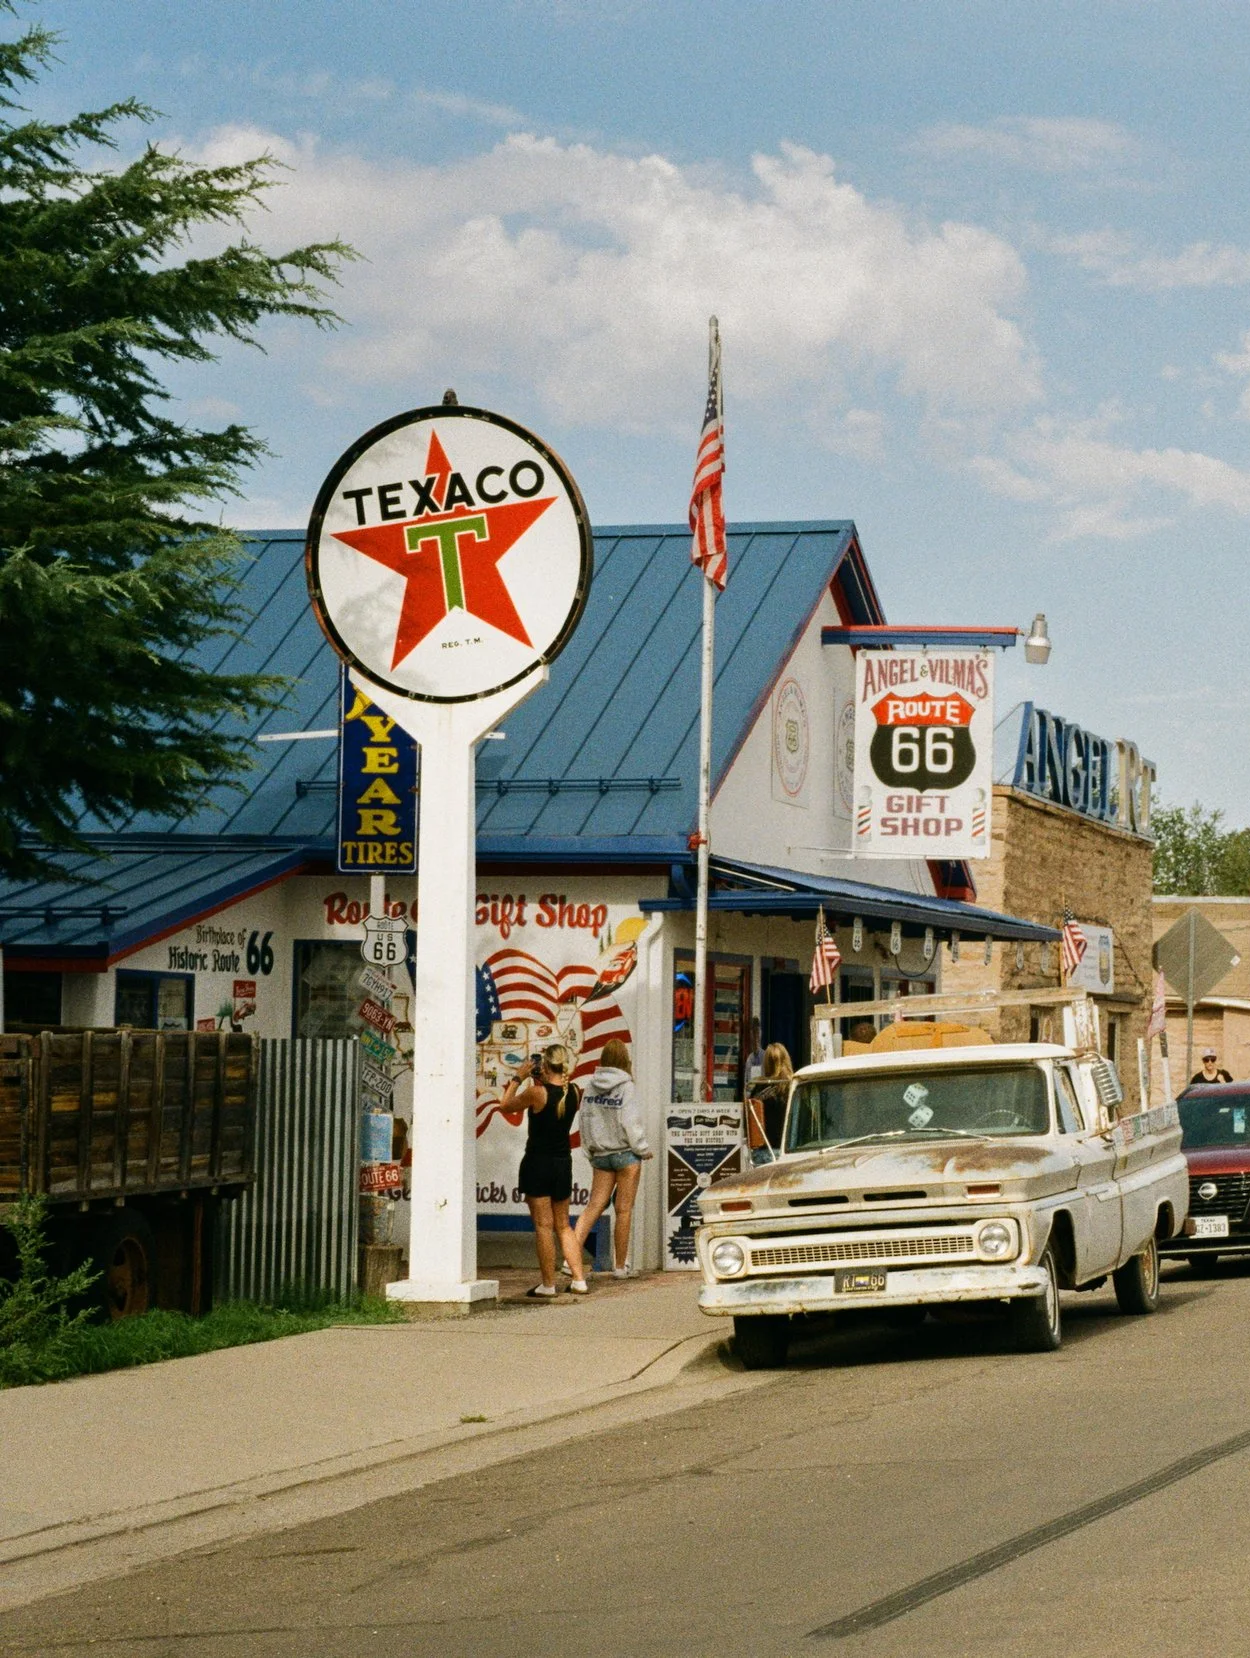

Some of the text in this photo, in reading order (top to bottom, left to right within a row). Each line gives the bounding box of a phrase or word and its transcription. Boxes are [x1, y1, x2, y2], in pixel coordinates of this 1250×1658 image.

[343, 460, 545, 526] TEXACO
[862, 654, 989, 703] ANGEL & VILMA'S
[886, 700, 960, 724] ROUTE
[891, 726, 954, 773] 66
[1012, 701, 1118, 824] ANGEL
[886, 795, 950, 814] GIFT
[880, 818, 963, 836] SHOP
[342, 841, 415, 865] TIRES
[323, 892, 407, 925] Rote
[536, 894, 607, 938] Shop
[196, 924, 248, 950] Birthplace of
[167, 930, 274, 975] Historic Route 66
[373, 942, 397, 961] 66
[584, 1094, 623, 1106] retired
[361, 1170, 399, 1185] OUTE 66
[1196, 1223, 1226, 1234] GZ-1383
[870, 1273, 885, 1286] 66
